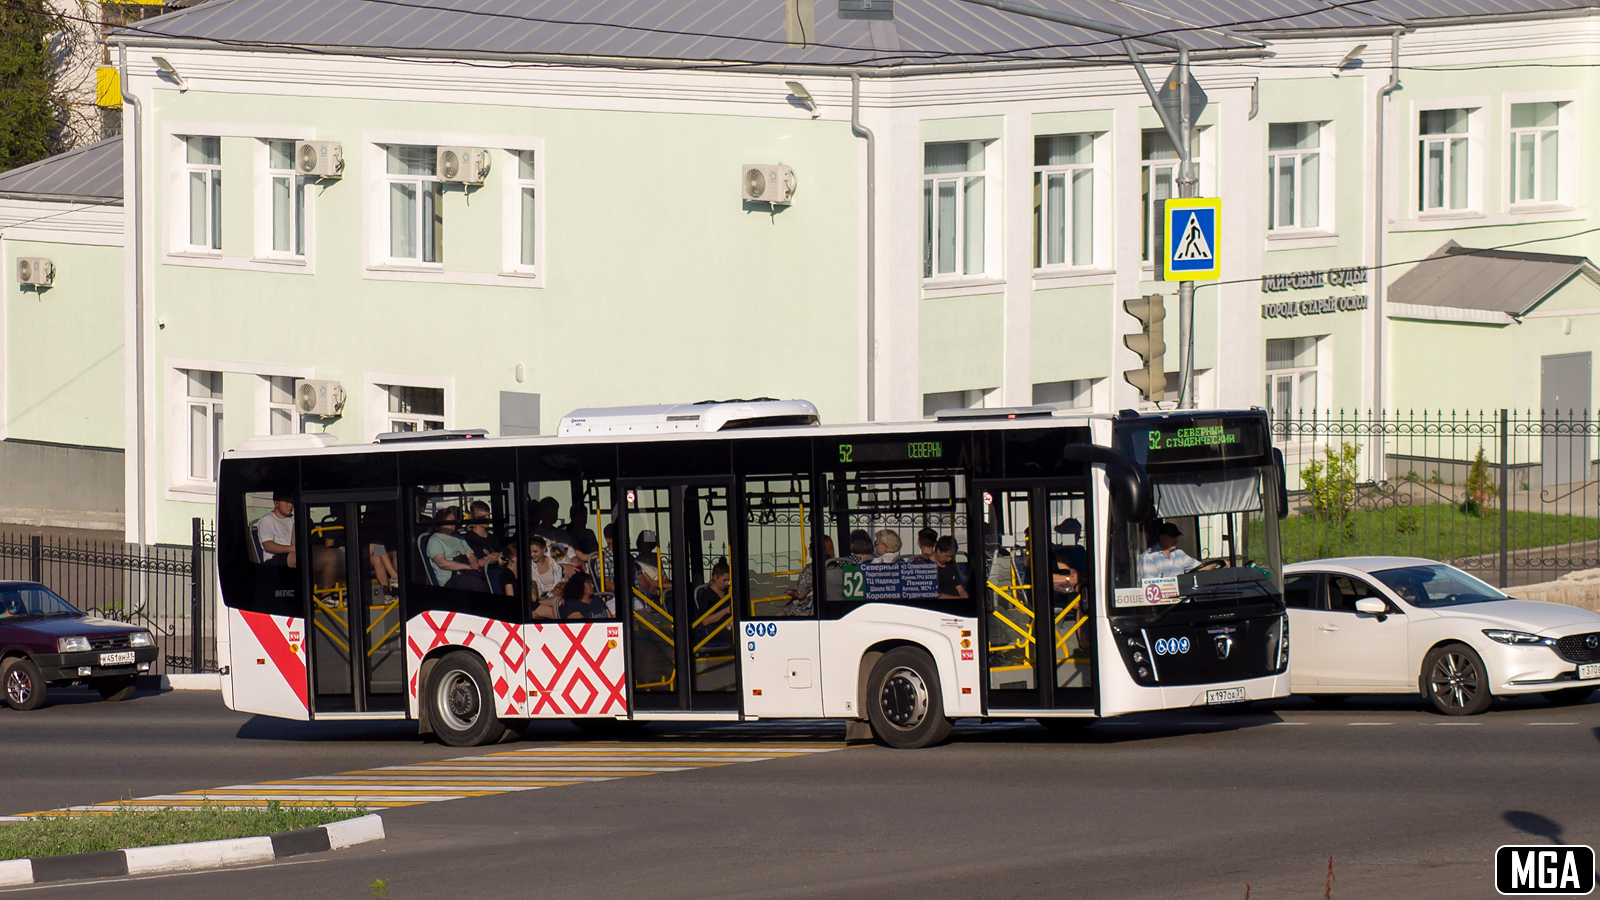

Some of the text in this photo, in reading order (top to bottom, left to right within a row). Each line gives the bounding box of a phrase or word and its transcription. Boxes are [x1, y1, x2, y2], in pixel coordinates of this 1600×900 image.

[1262, 266, 1368, 292] МИРОВЫЕ СУДЬИ
[1262, 295, 1368, 319] ГОРОДА СТАРЫЙ ОСКОЛ
[1177, 426, 1223, 438] СЕВЕРНЫЙ
[1148, 430, 1161, 450] 52
[1166, 434, 1235, 447] СТУДЕНЧЕСКИЙ
[839, 444, 852, 462] 52
[861, 564, 899, 572] Северный
[843, 572, 864, 597] 52
[866, 592, 901, 600] Королева
[1117, 595, 1143, 604] БОШЕ
[1147, 586, 1160, 601] 52
